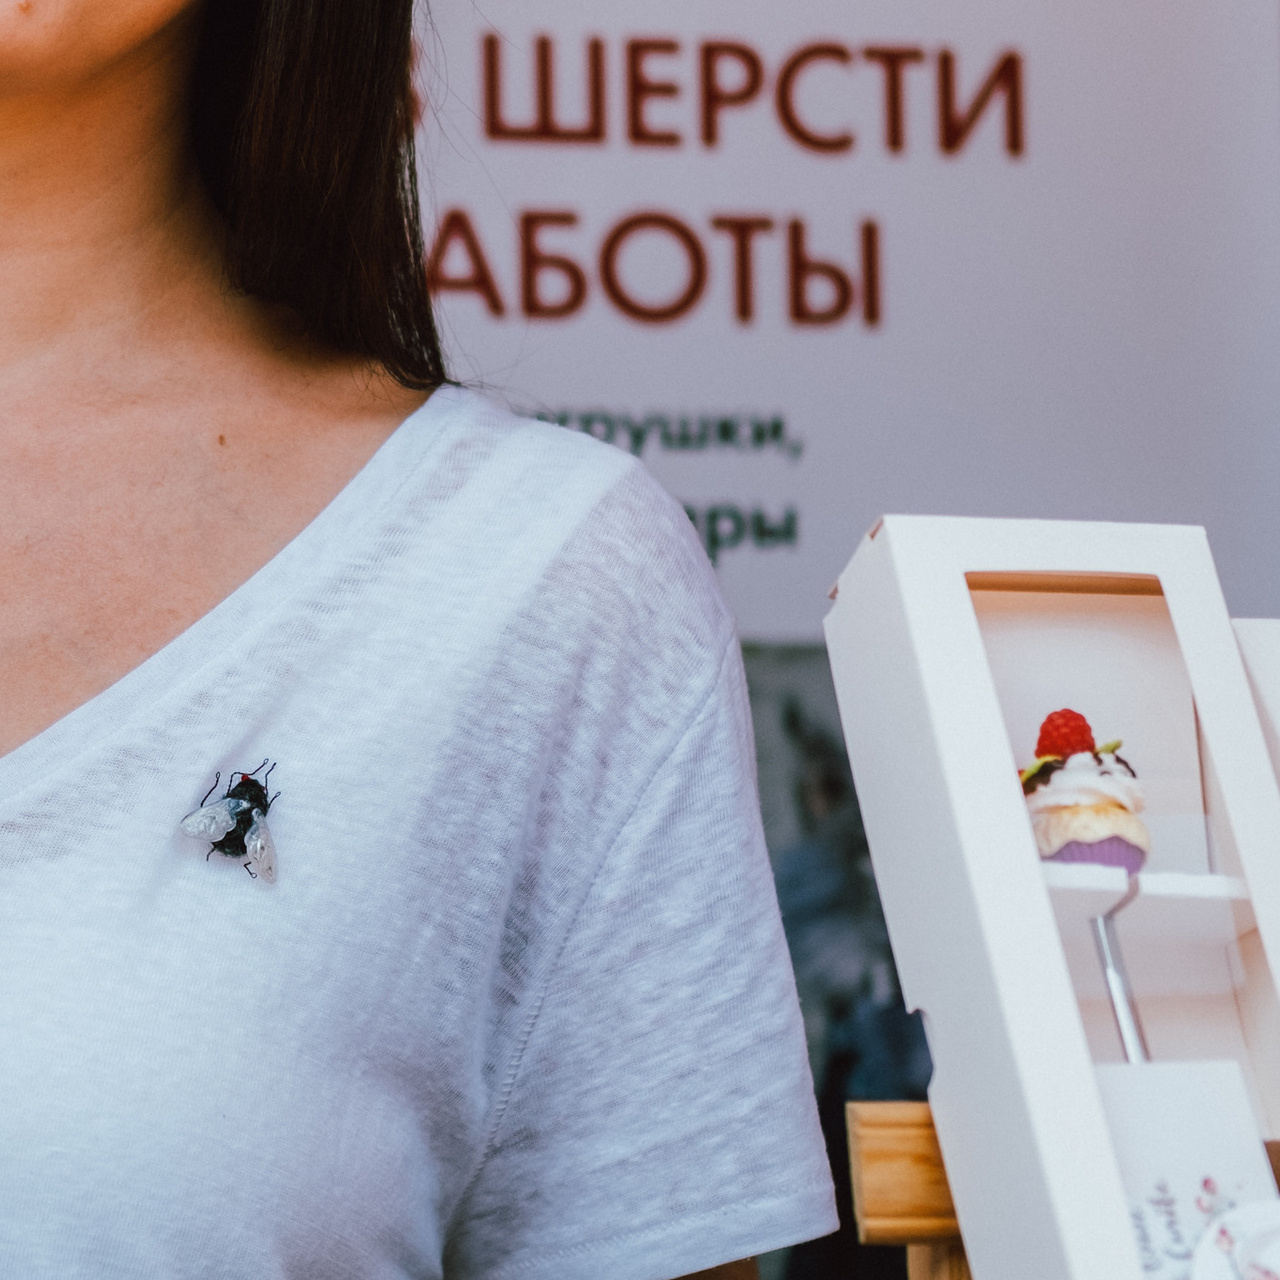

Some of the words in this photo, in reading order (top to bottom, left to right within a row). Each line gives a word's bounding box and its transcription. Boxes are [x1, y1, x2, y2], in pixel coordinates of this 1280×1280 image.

[482, 32, 1024, 158] ШЕРСТИ
[425, 207, 882, 331] АБОТЫ
[535, 410, 805, 465] рушки,
[682, 504, 799, 568] ры
